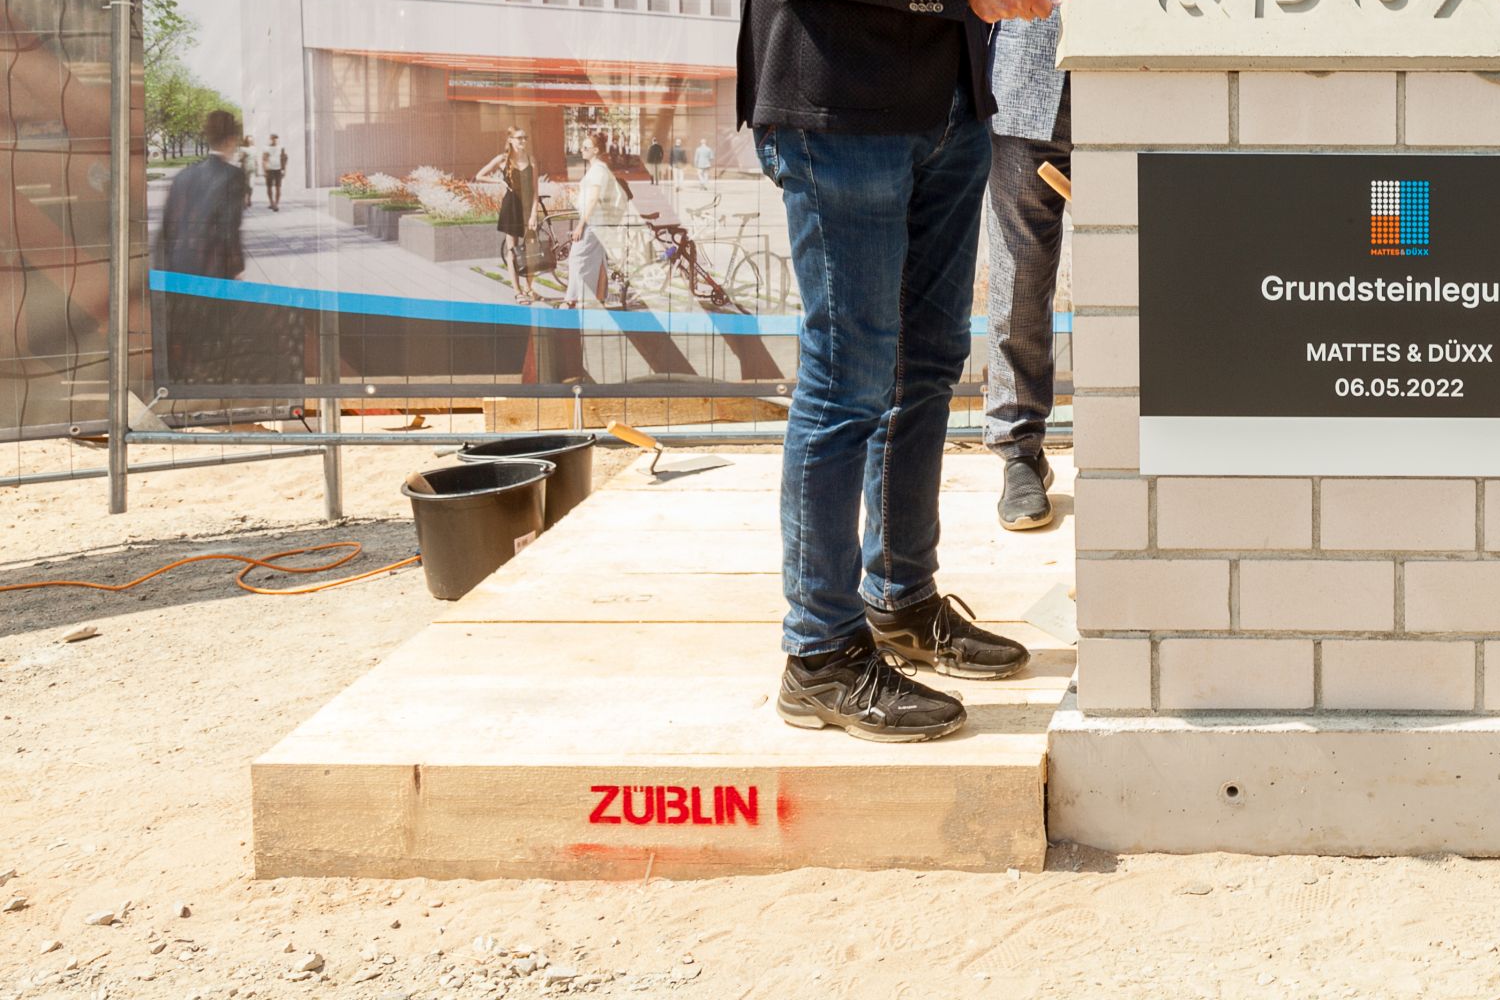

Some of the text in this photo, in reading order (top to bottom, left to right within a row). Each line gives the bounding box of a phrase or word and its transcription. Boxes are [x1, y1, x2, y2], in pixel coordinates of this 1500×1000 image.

[1306, 338, 1494, 363] MATTES & DÜXX
[1334, 377, 1465, 398] 06.05.2022
[589, 785, 759, 826] ZÜBLIN
